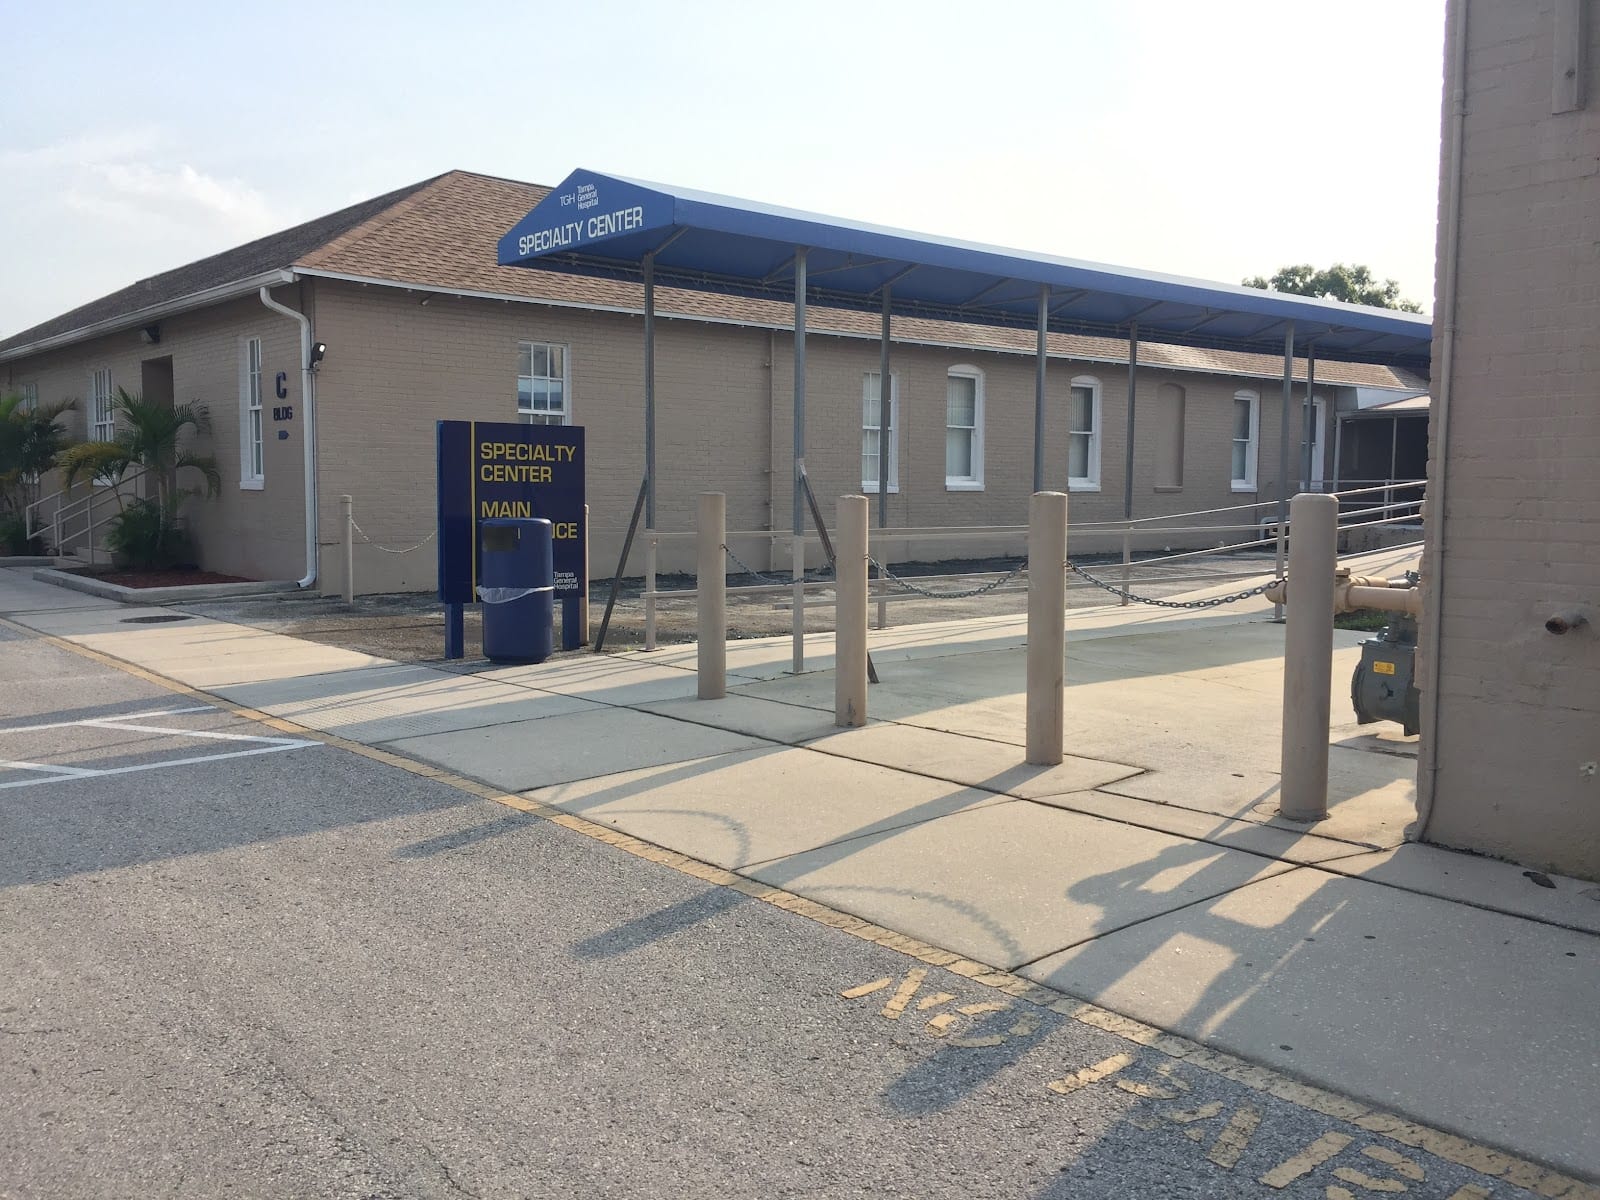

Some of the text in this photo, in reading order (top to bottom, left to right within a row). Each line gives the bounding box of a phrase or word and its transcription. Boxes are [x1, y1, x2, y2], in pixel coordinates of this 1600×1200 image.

[577, 184, 595, 193] Tampa
[578, 189, 598, 202] General
[560, 193, 576, 207] TGH
[577, 197, 599, 210] Hospital
[519, 206, 643, 256] SPECIALTY CENTER
[276, 371, 287, 399] C
[273, 406, 293, 421] BLDG
[480, 442, 577, 462] SPECIALTY
[480, 465, 552, 483] CENTER
[481, 501, 531, 518] MAIN
[553, 577, 578, 585] General
[554, 571, 574, 579] Tampa
[554, 583, 579, 591] Hospital
